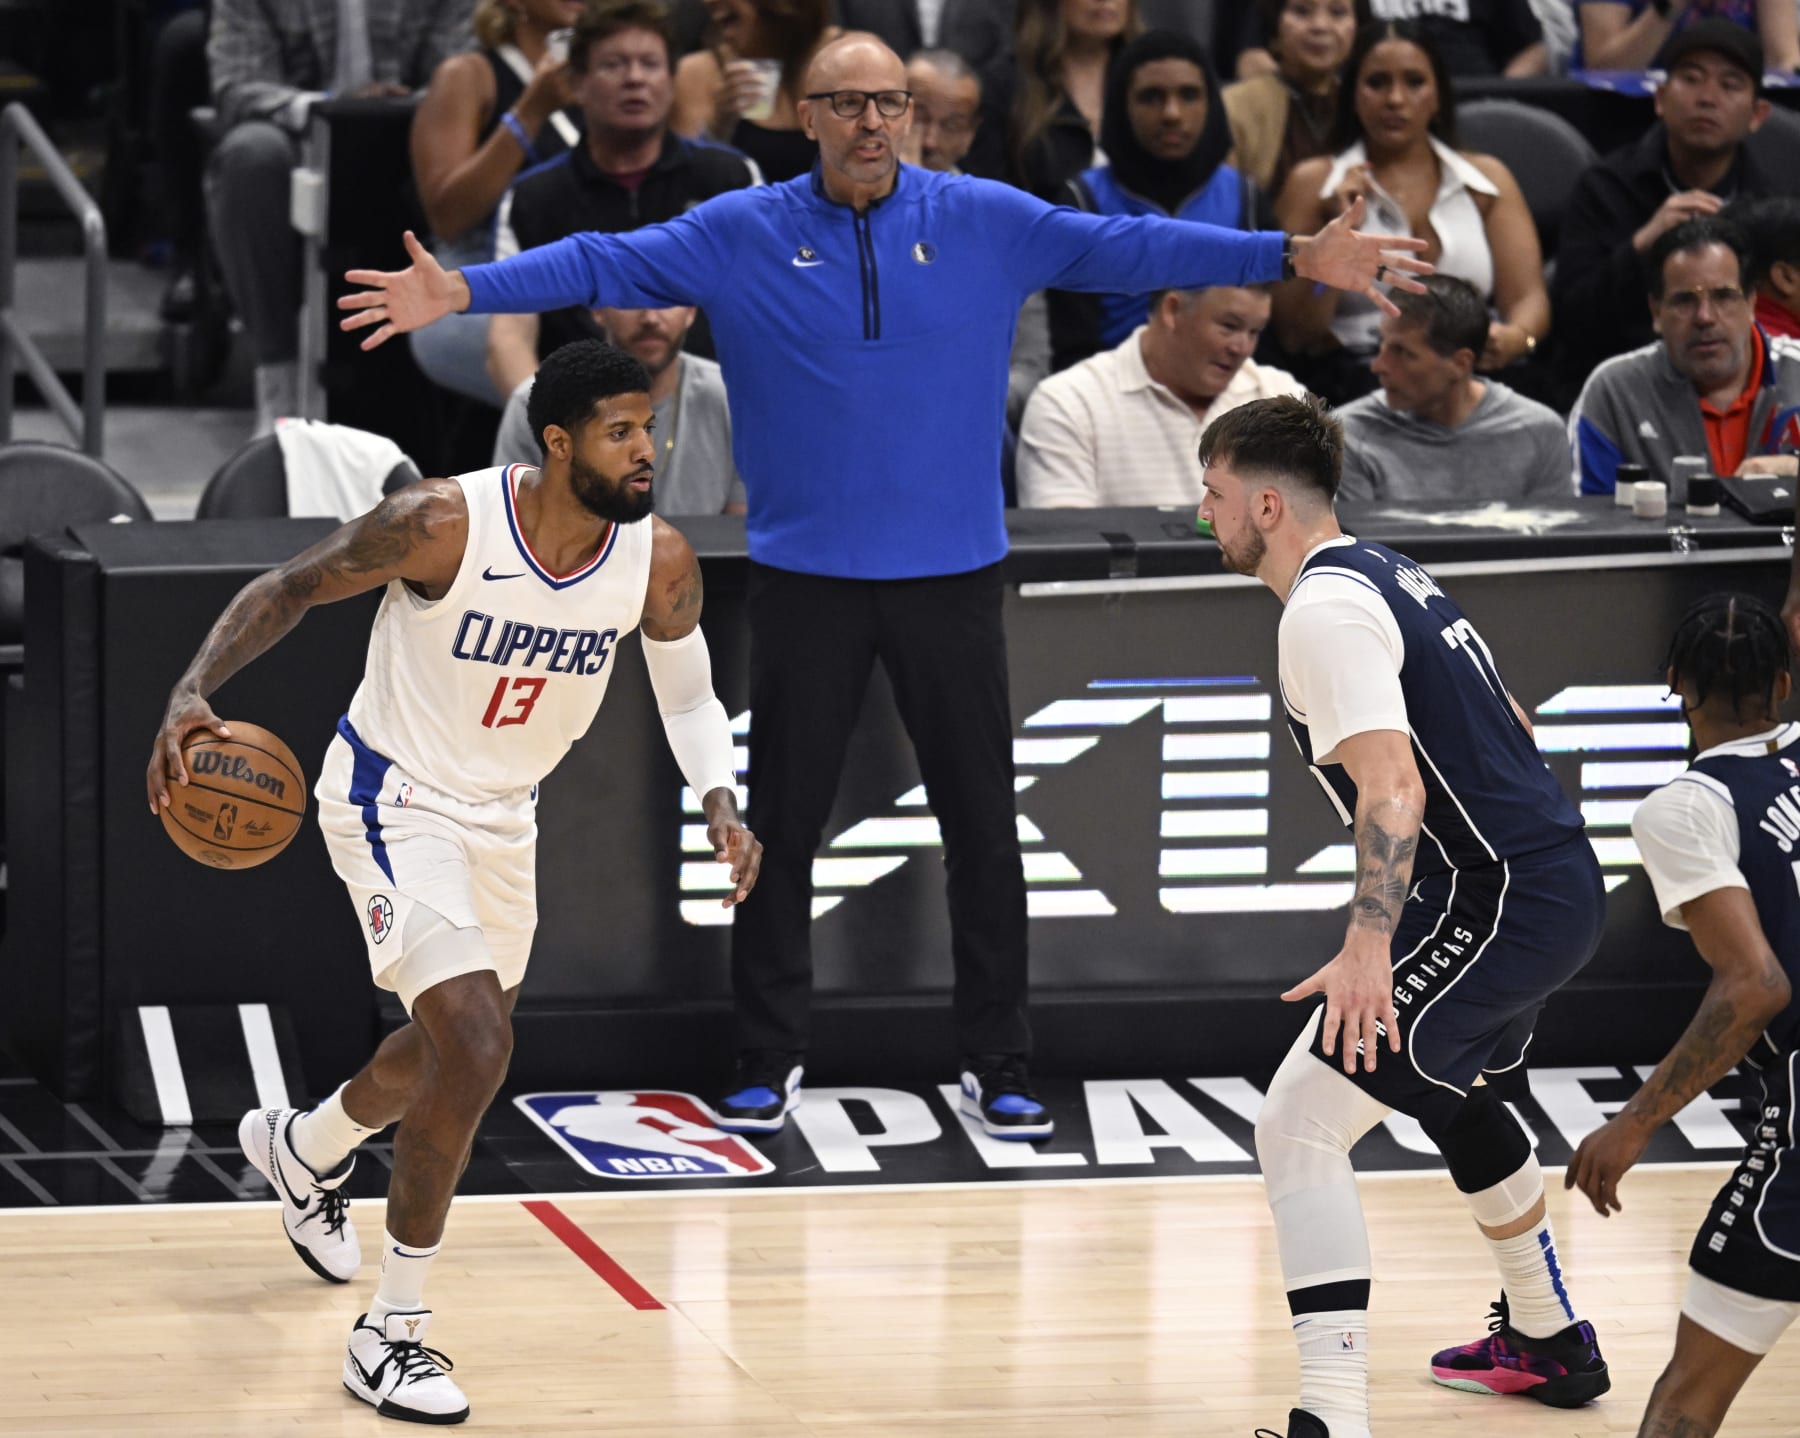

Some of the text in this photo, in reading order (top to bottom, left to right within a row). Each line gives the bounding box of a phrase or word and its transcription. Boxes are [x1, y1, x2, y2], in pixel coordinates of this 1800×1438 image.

[451, 610, 618, 675] CLIPPERS
[481, 677, 548, 728] 13
[192, 750, 285, 800] Wilson
[607, 1156, 705, 1173] NBA
